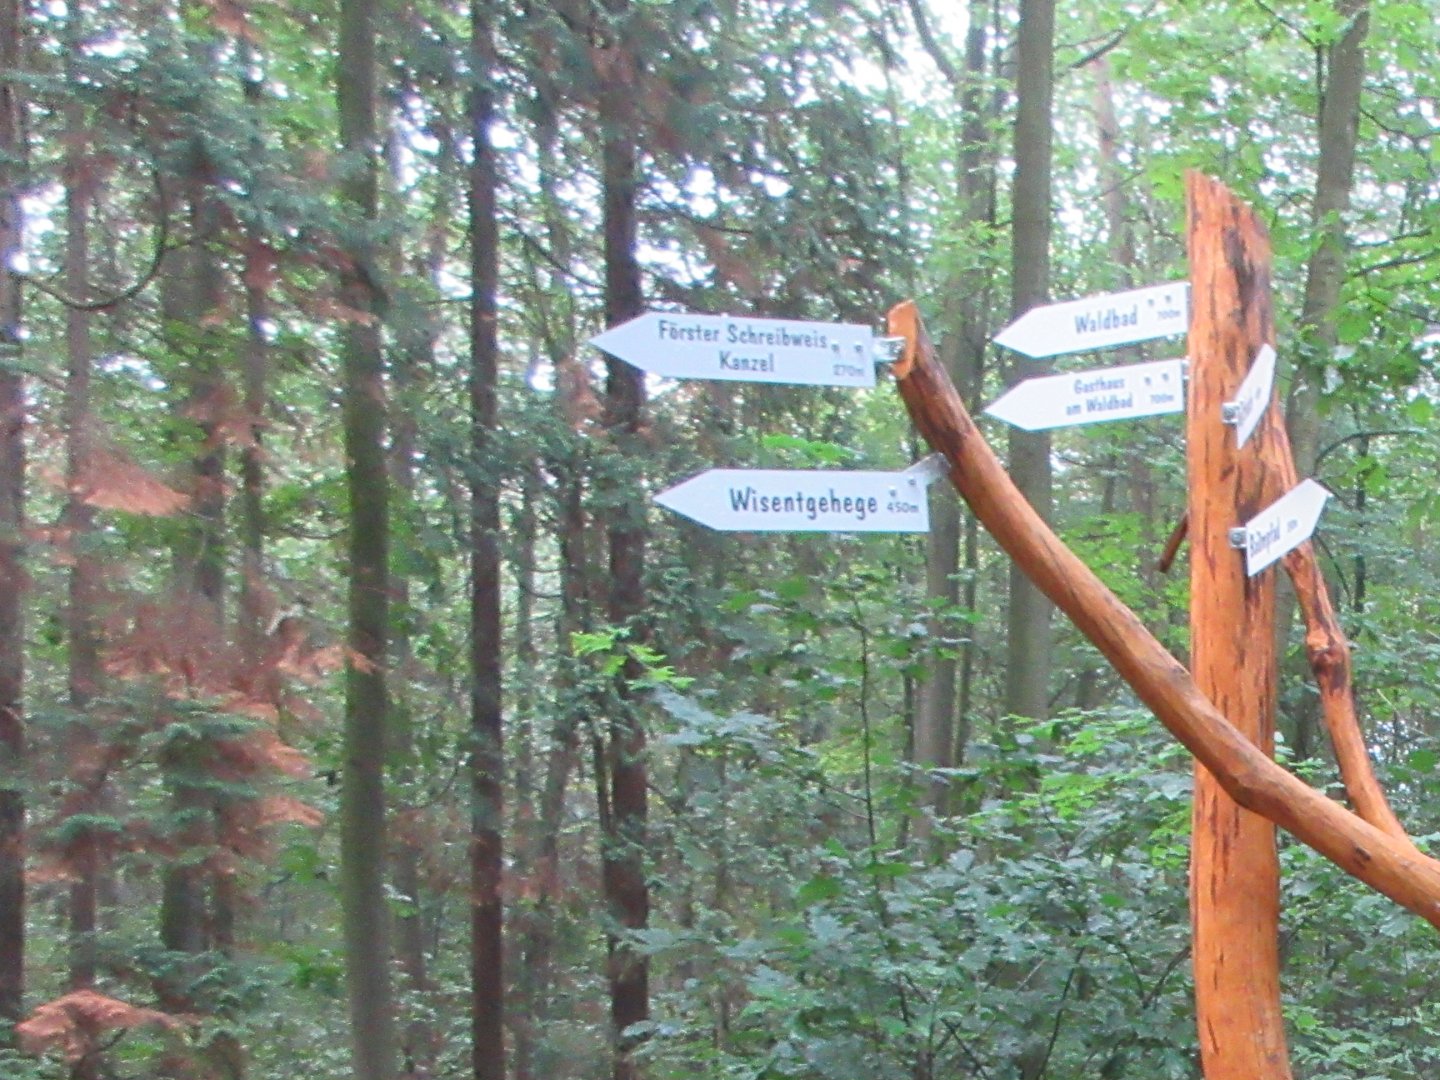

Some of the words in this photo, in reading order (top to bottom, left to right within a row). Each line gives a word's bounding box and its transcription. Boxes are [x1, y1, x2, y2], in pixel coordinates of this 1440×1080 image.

[1075, 304, 1138, 334] Waldbad
[658, 319, 720, 342] Förster
[727, 324, 828, 349] Schreibweis
[719, 350, 775, 373] Kanzel
[832, 363, 865, 377] 270m
[1074, 377, 1125, 394] Gasthaus
[1086, 392, 1133, 413] Waldbad
[729, 486, 878, 520] Wisentgehege
[887, 502, 919, 513] 450m
